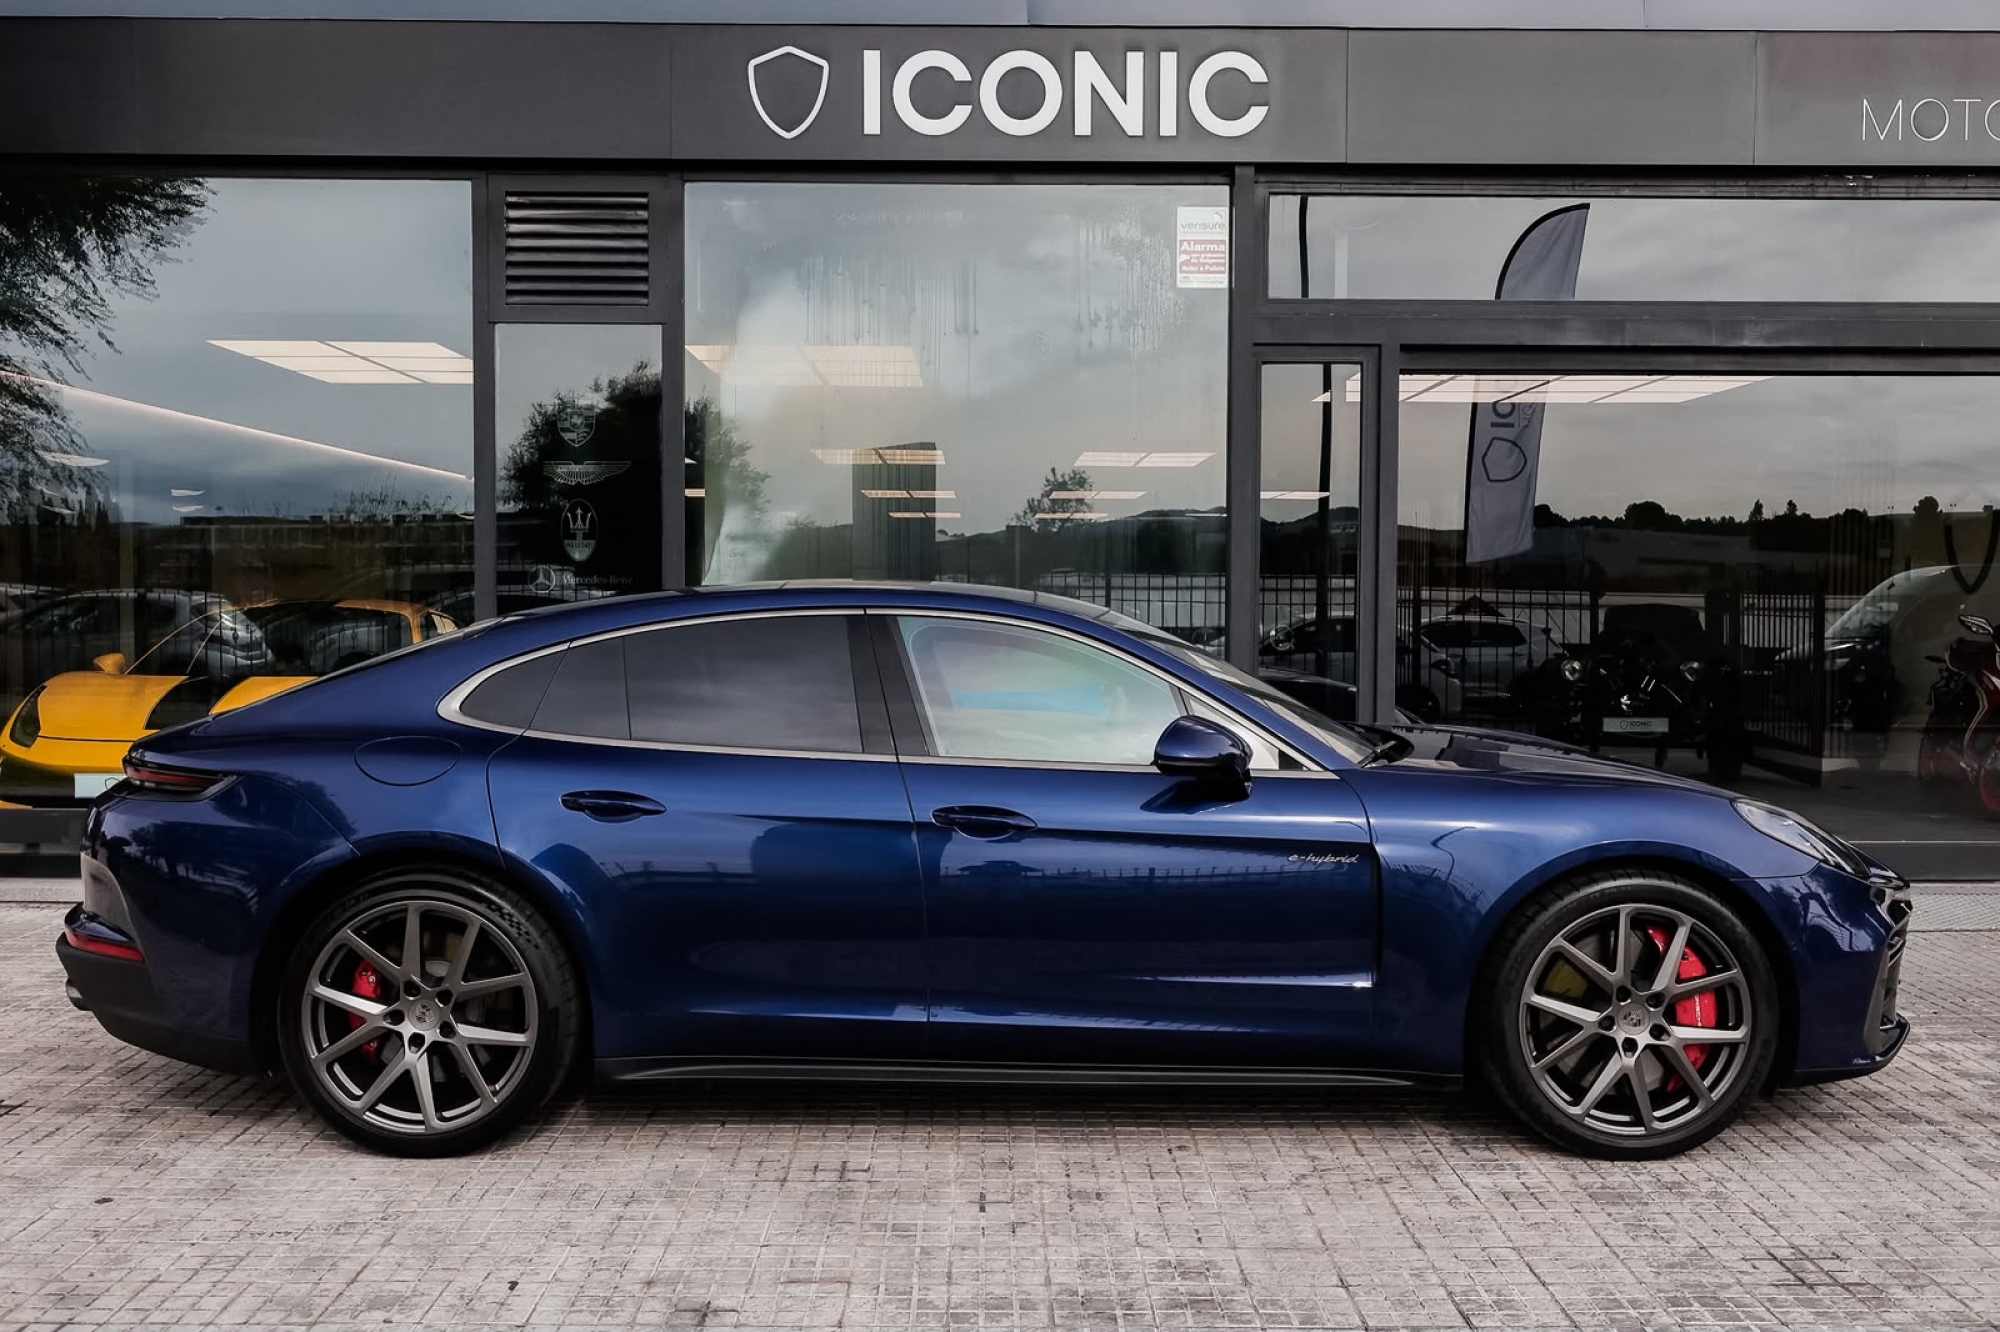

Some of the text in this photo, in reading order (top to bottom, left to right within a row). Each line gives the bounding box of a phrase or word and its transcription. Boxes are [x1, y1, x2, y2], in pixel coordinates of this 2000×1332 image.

[863, 49, 1269, 137] ICONIC
[1180, 241, 1225, 251] Alarma
[1288, 853, 1360, 867] e-hybrid
